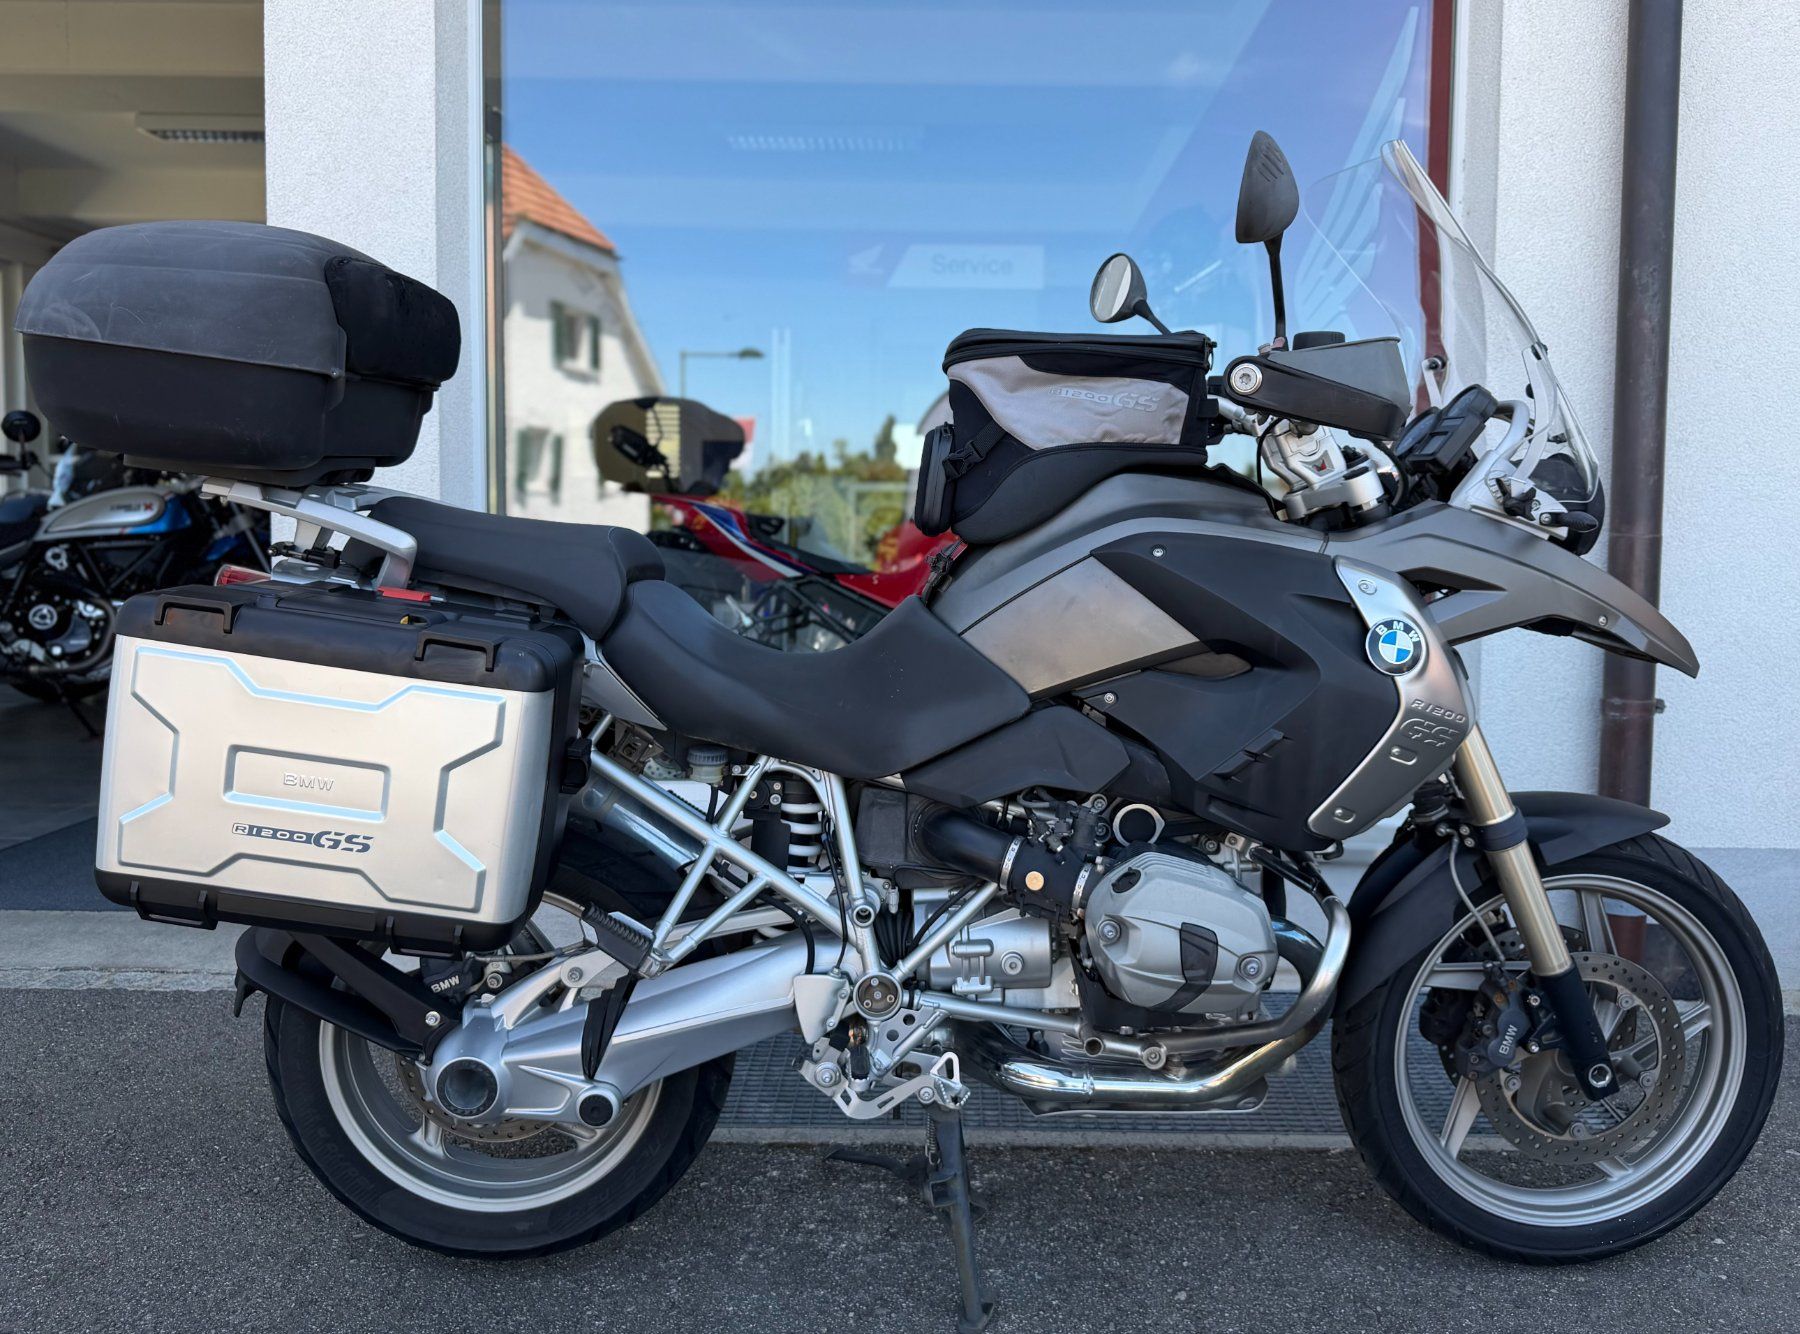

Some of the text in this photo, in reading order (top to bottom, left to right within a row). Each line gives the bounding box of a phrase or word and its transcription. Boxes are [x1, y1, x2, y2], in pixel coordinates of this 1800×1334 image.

[1375, 621, 1420, 642] BMW
[1411, 699, 1466, 723] R1200
[283, 772, 335, 791] BMW
[430, 975, 460, 993] BMW
[1499, 1024, 1518, 1055] BMW
